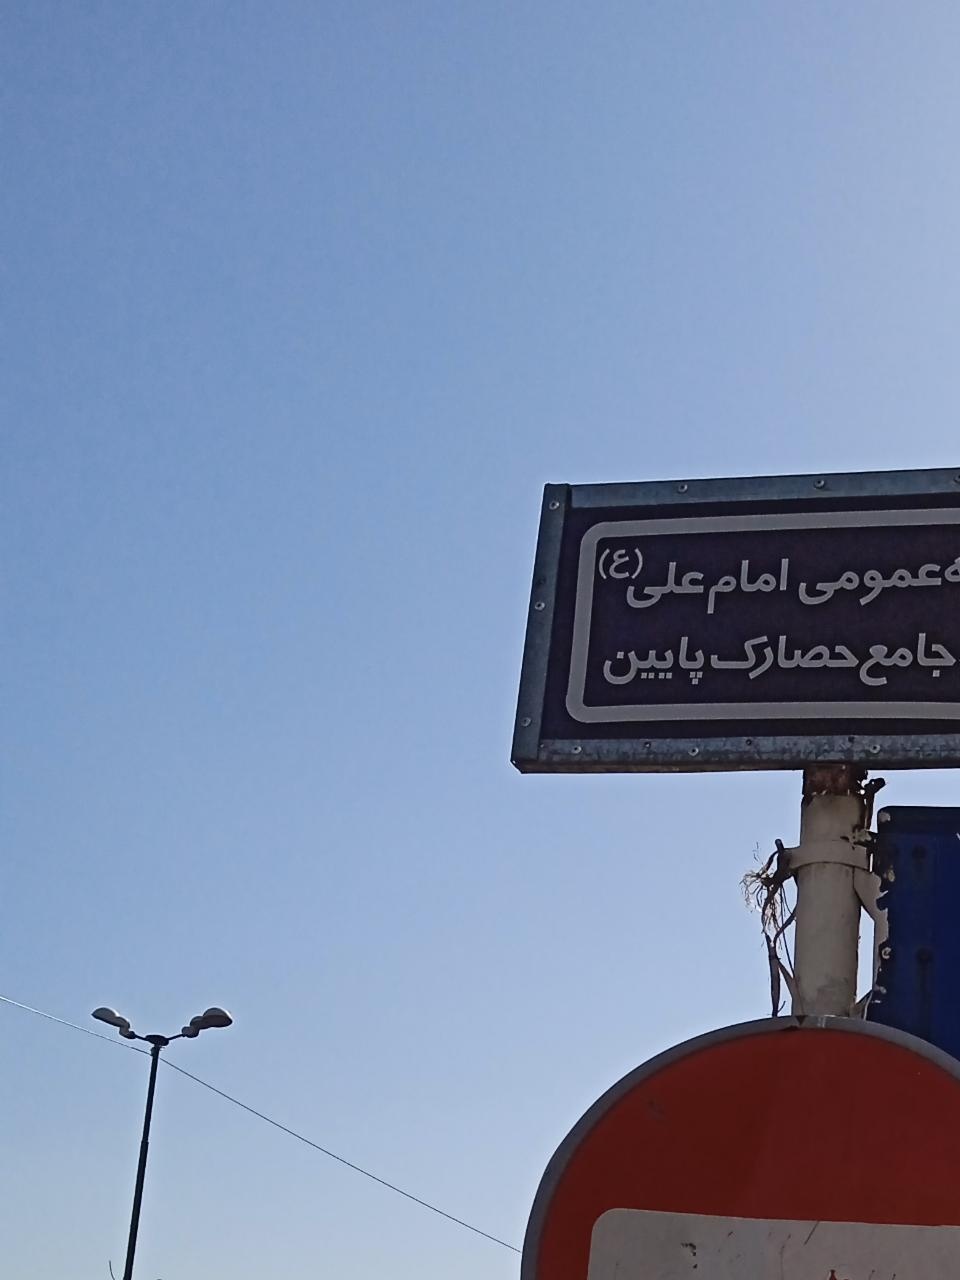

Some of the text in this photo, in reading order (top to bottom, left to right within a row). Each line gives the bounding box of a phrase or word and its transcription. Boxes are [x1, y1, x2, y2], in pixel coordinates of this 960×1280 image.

[707, 558, 789, 614] امام
[798, 563, 942, 606] عمومی
[603, 636, 705, 686] پایین
[710, 635, 860, 680] حصارک
[859, 632, 957, 686] جامع
